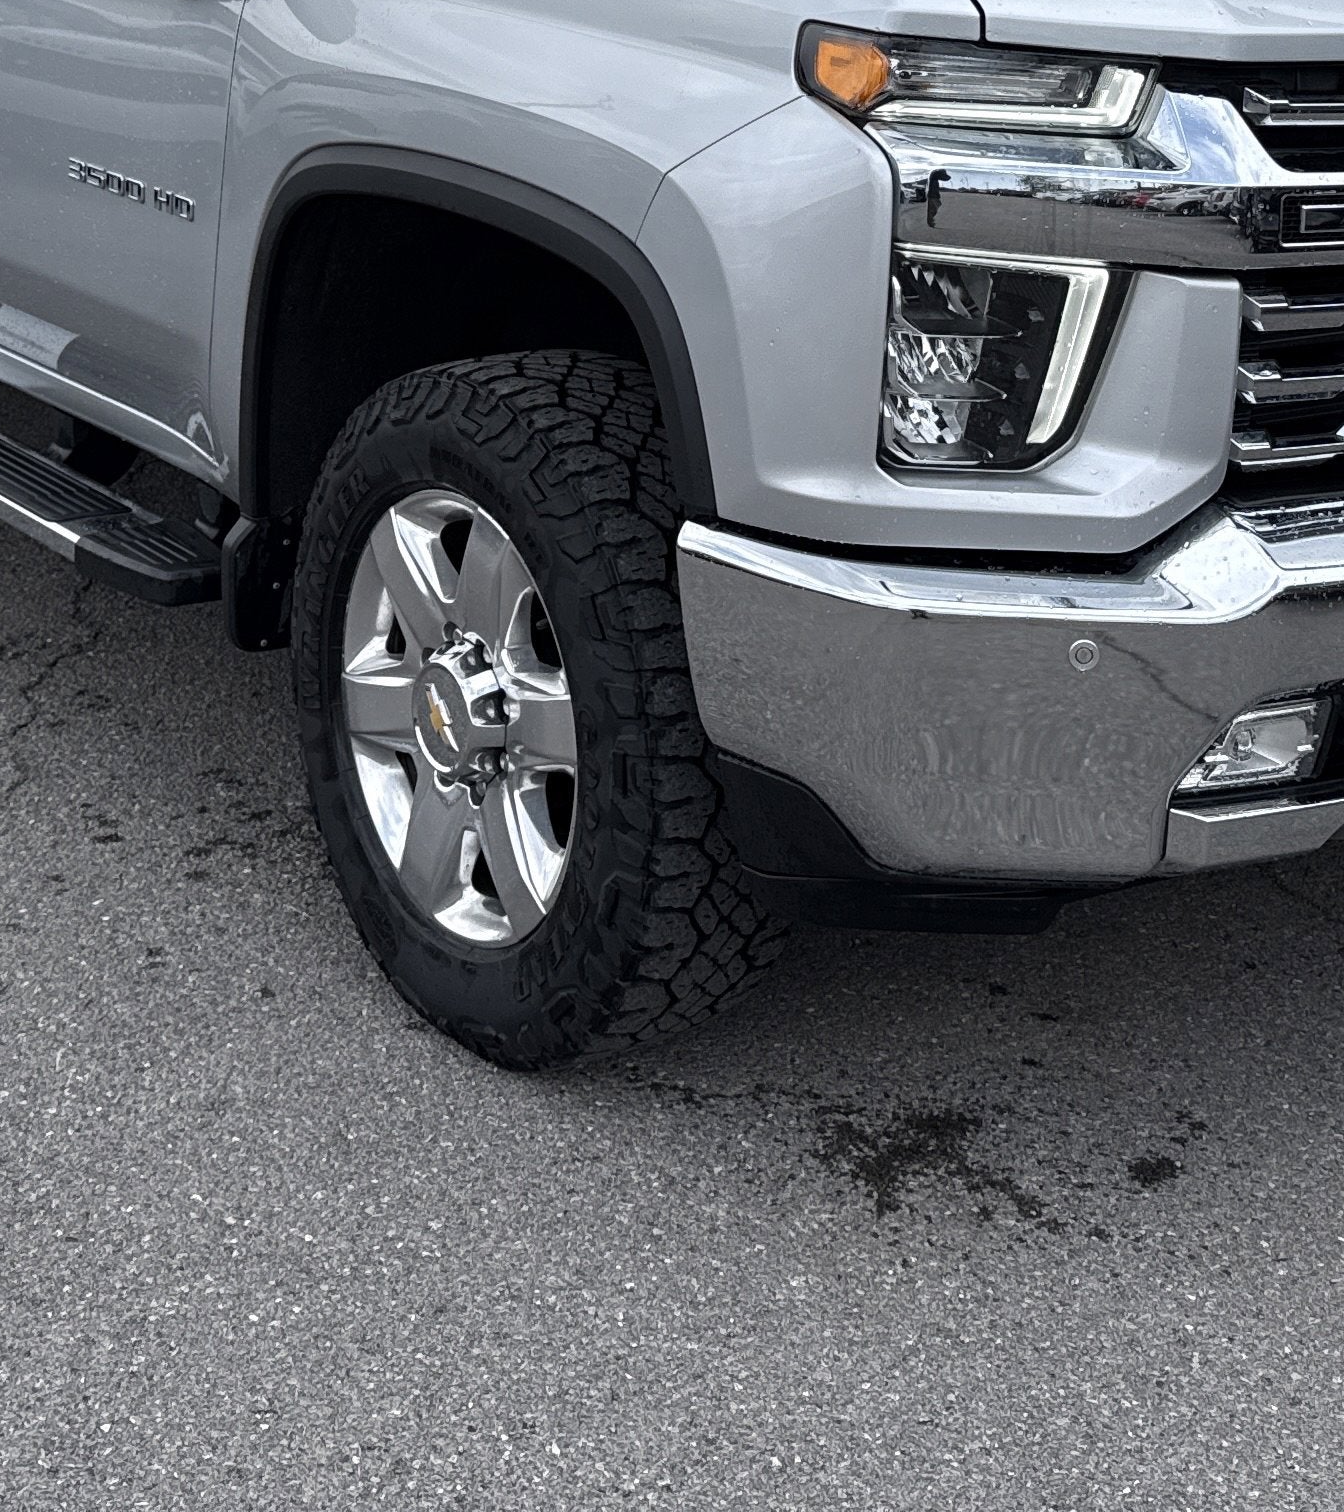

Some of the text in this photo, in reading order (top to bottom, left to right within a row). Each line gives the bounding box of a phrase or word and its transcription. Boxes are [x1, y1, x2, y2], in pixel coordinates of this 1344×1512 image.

[68, 156, 196, 223] 3500 HD
[299, 466, 371, 710] WRANGLER
